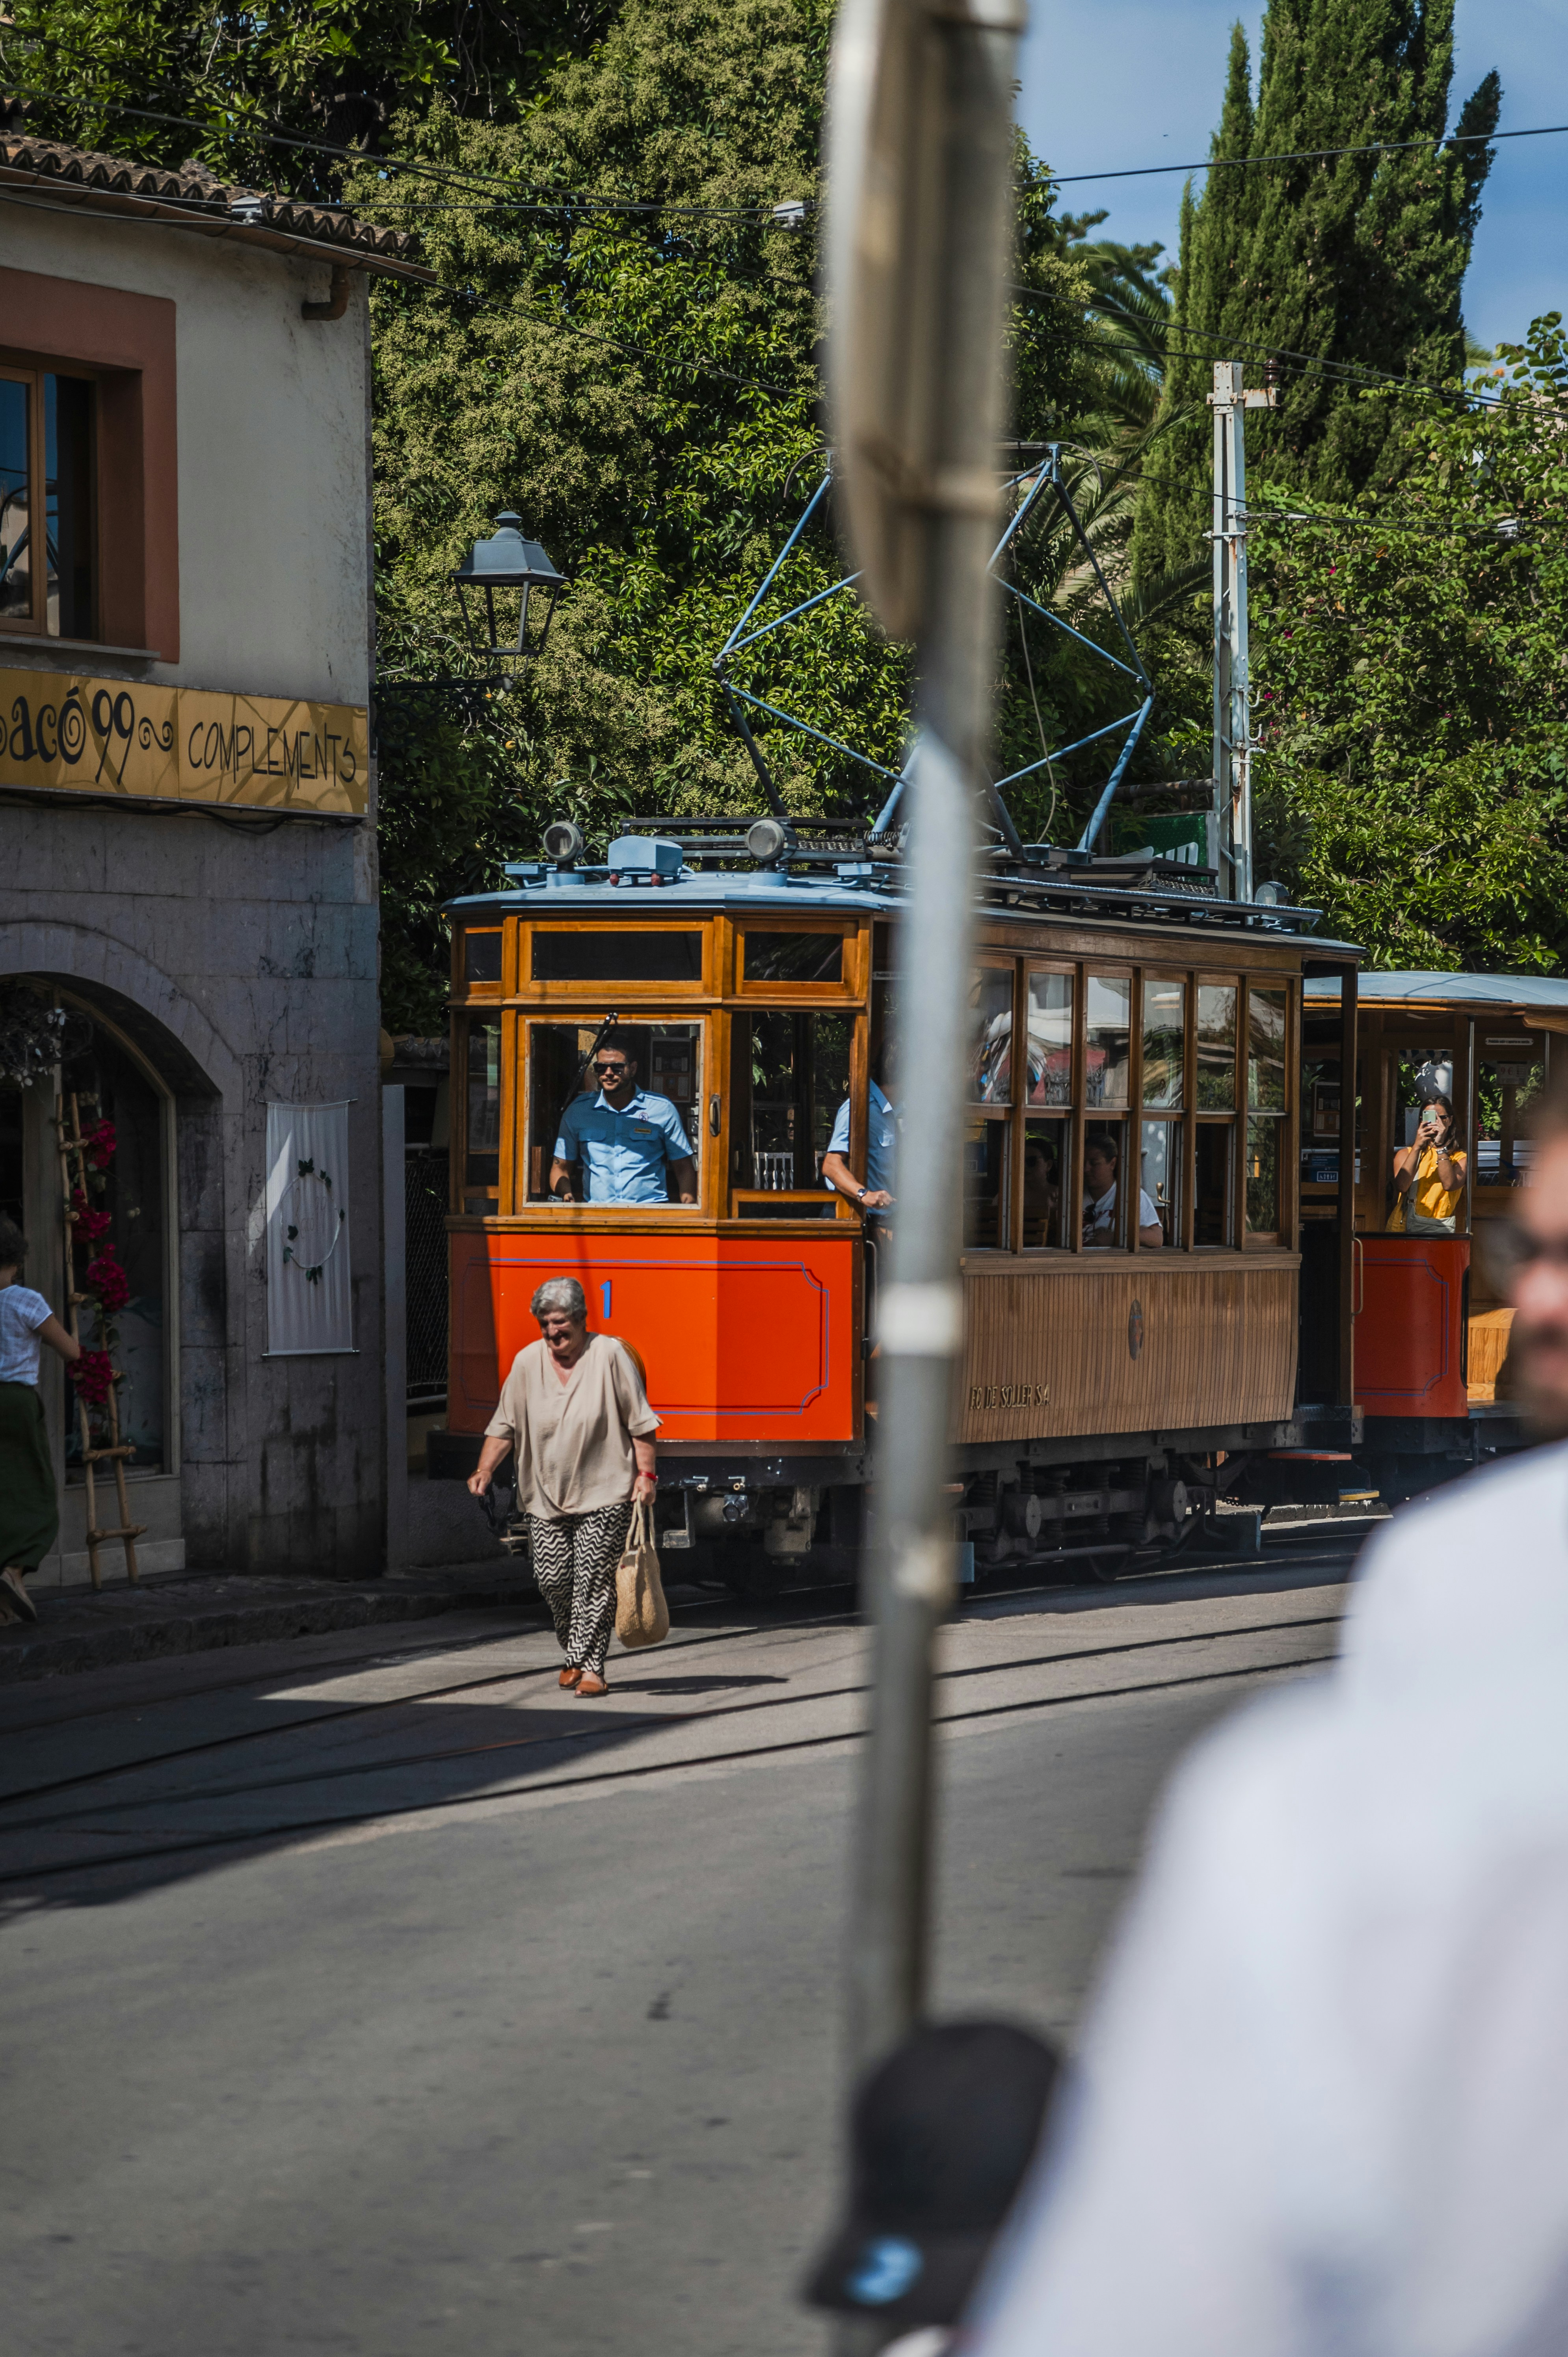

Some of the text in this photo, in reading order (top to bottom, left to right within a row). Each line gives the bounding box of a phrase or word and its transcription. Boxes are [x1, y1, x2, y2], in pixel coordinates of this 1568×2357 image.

[188, 722, 356, 789] COMPLEMENTS
[600, 1280, 612, 1319] 1
[986, 1386, 998, 1409] DE
[1001, 1384, 1033, 1408] SOLLER
